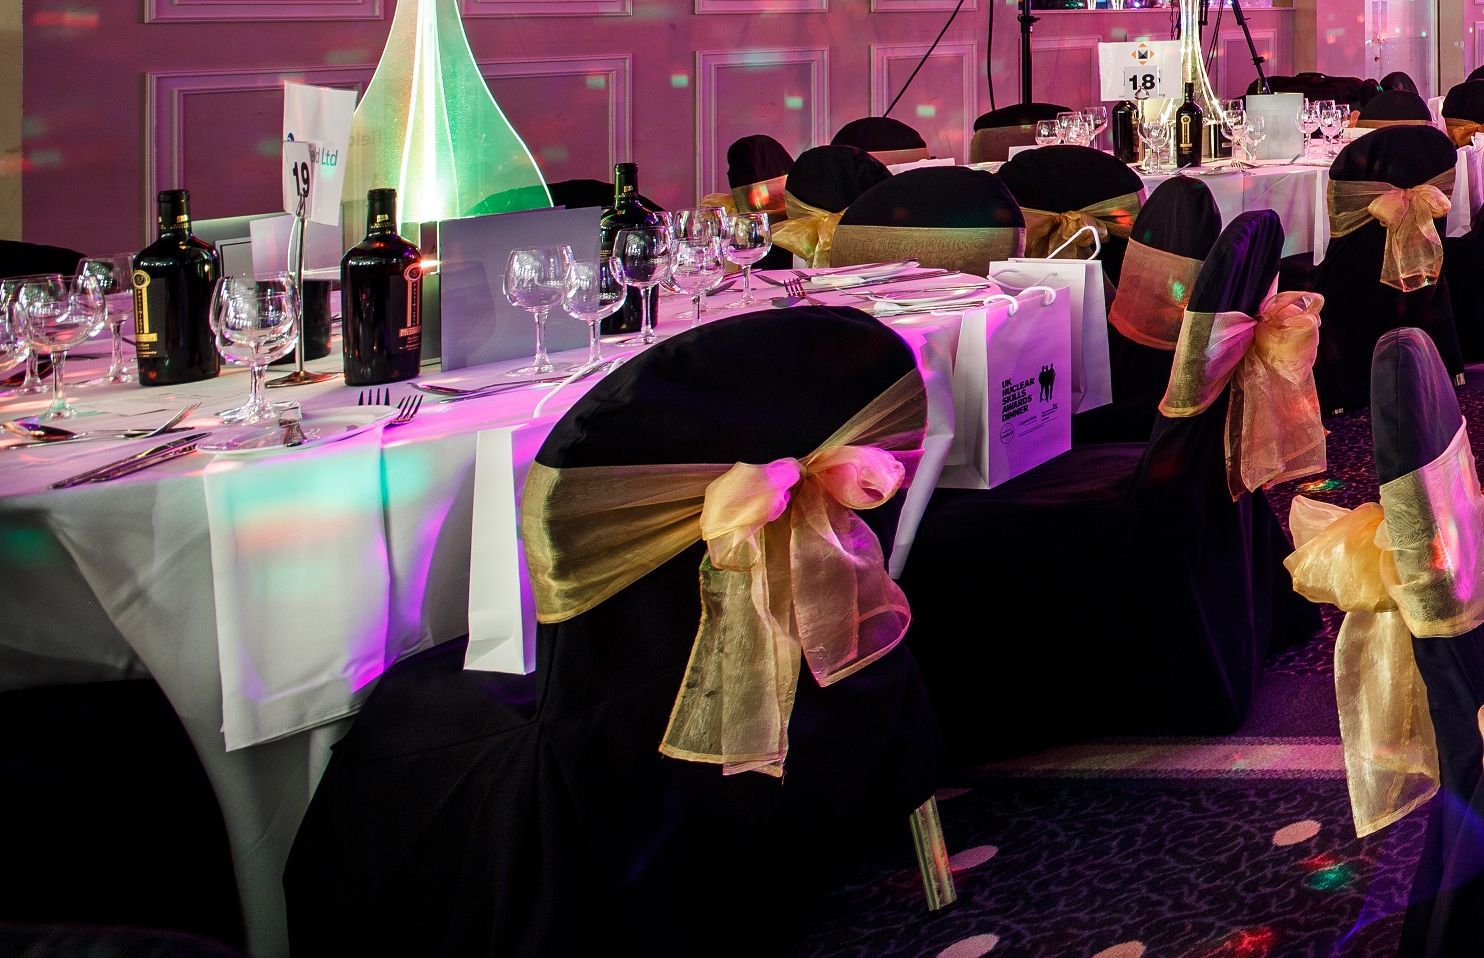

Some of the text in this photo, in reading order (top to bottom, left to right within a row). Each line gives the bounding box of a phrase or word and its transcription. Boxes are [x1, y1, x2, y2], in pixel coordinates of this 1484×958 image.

[1128, 73, 1156, 91] 18
[321, 147, 339, 167] Ltd
[292, 161, 310, 198] 19
[1002, 378, 1012, 388] UK
[1002, 377, 1035, 397] NUCLEAR
[1002, 389, 1027, 405] SKILLS
[1002, 395, 1033, 414] AWARDS
[1002, 405, 1029, 423] DINNER
